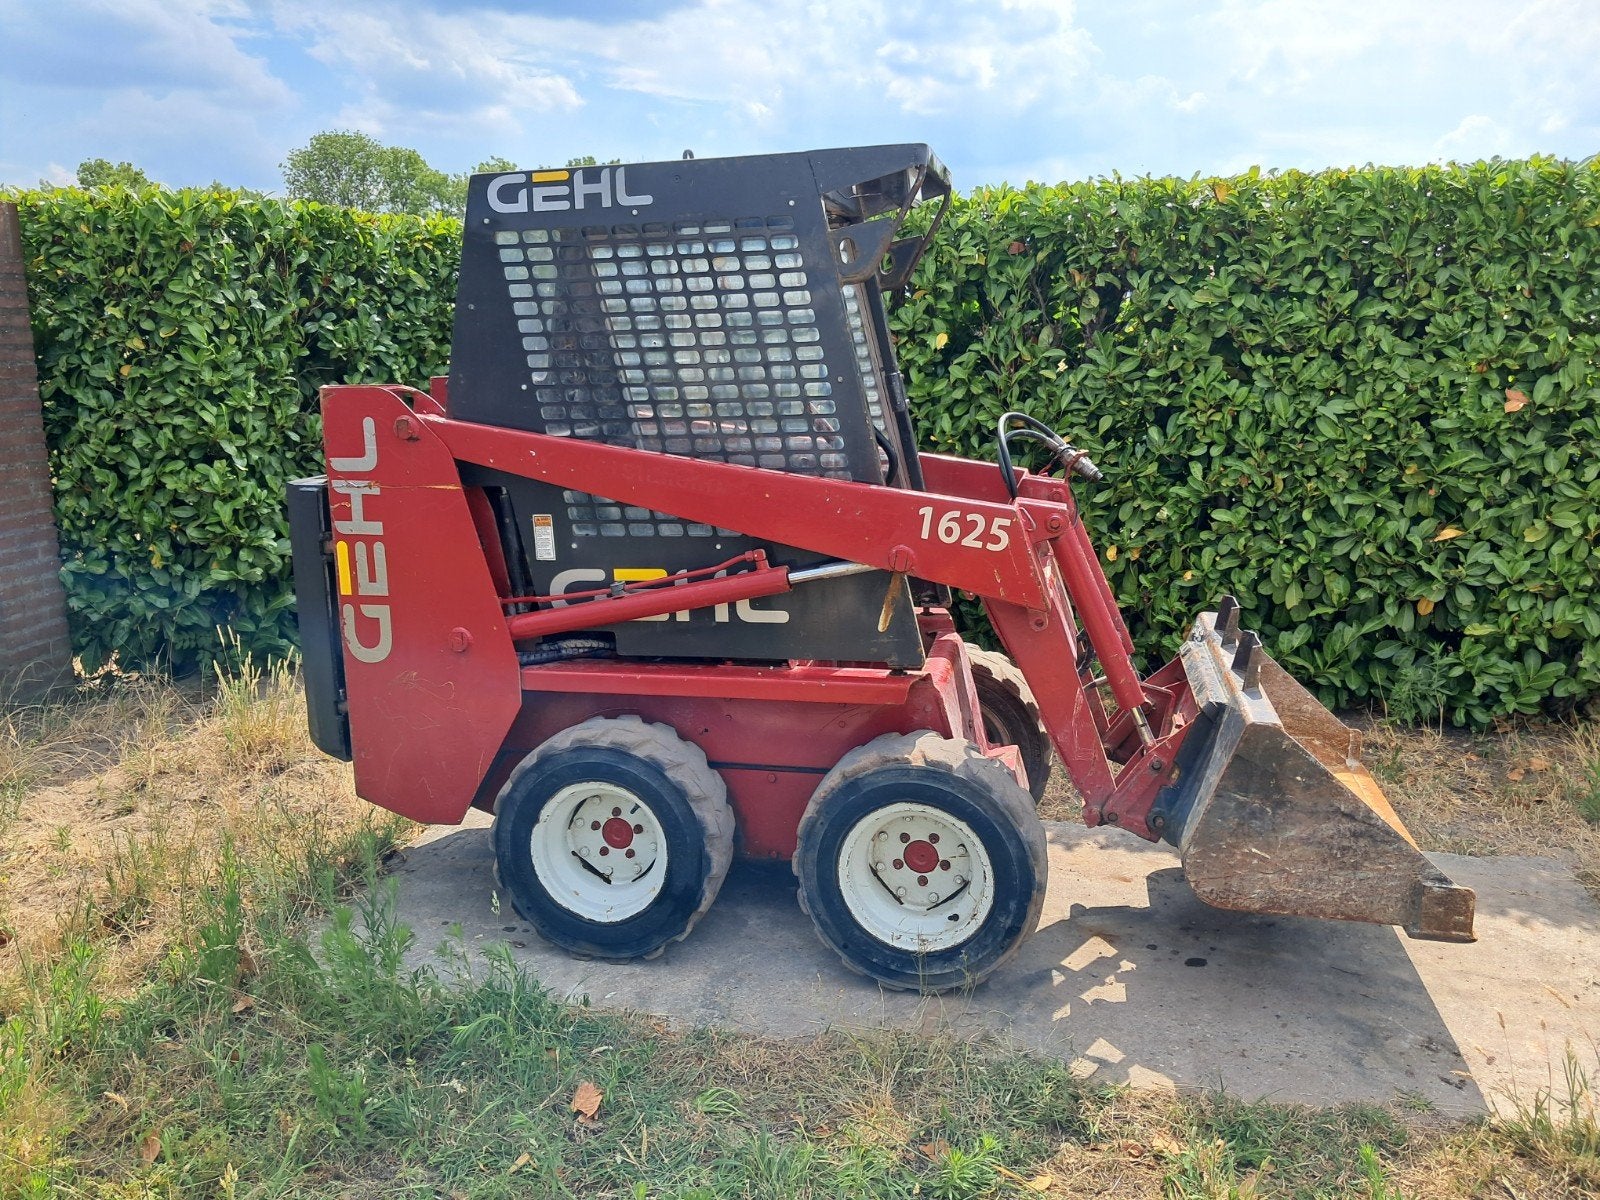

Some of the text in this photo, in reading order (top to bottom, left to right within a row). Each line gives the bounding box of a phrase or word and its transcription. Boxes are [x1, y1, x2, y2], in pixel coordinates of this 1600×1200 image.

[487, 167, 654, 213] GEHL
[330, 416, 393, 663] GEHL
[919, 506, 1012, 552] 1625
